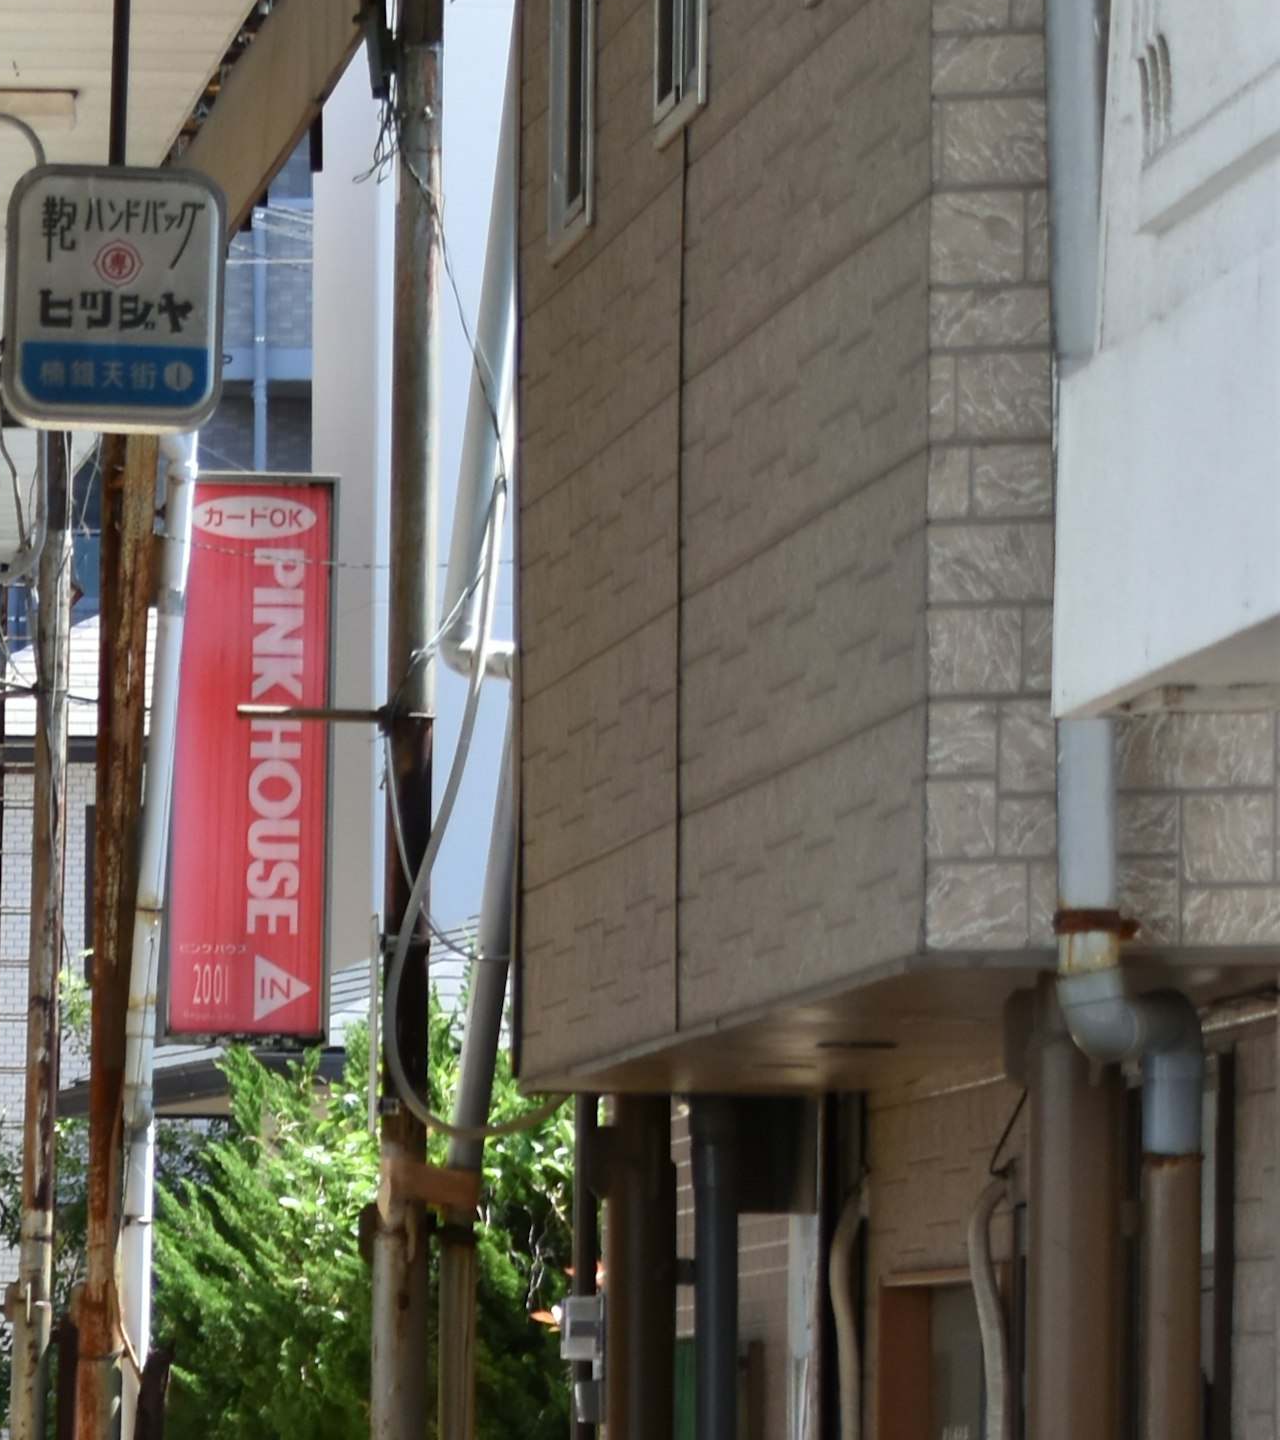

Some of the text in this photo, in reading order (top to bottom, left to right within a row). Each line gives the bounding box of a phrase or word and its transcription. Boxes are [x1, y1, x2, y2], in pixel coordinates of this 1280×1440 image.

[38, 289, 194, 334] ヒツジヤ
[203, 506, 303, 529] カードOK
[246, 547, 305, 936] PINK HOUSE
[192, 963, 230, 1005] 2001
[260, 977, 290, 1000] IN
